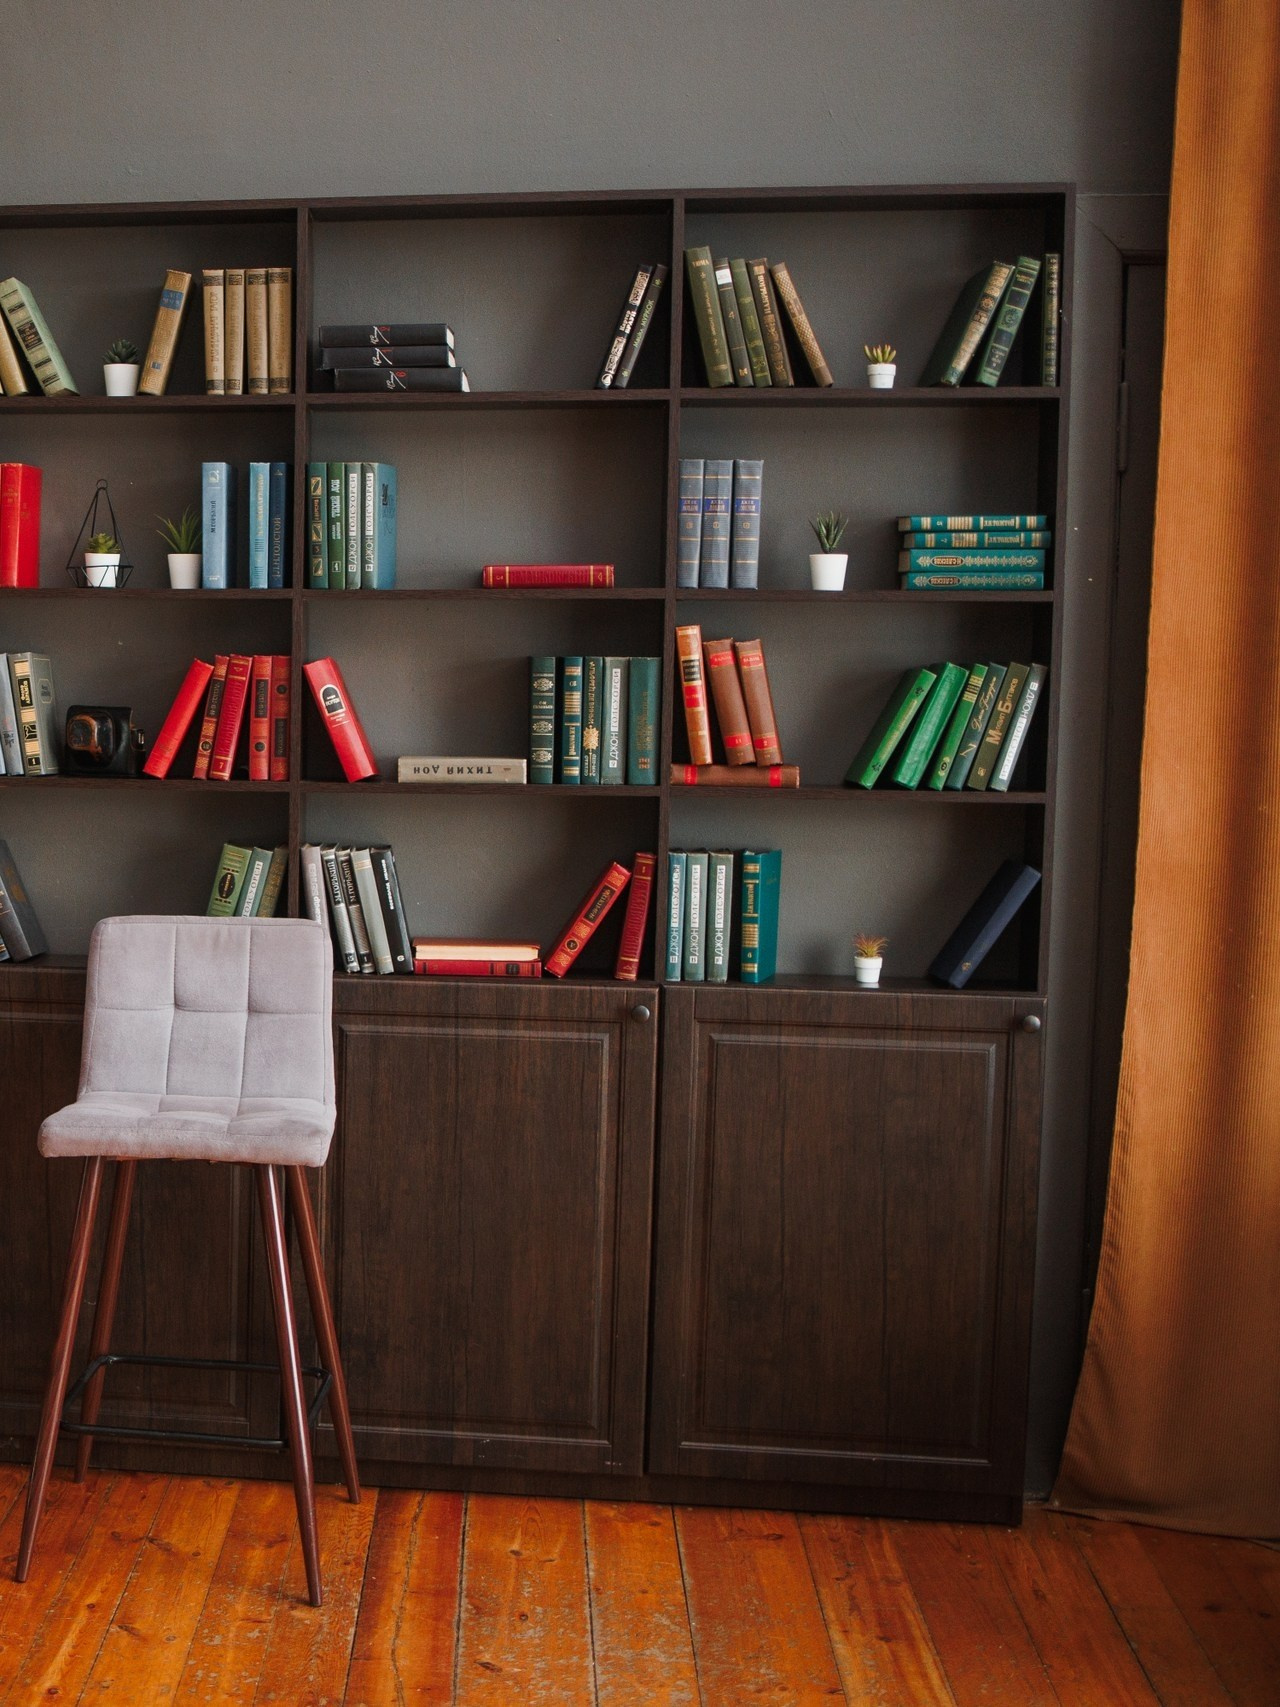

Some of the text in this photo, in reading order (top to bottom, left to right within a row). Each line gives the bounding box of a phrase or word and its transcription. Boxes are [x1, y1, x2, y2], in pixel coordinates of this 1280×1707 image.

[349, 536, 357, 564] ДЖОН
[366, 536, 374, 563] ДЖОН
[1023, 692, 1037, 720] ДЖОН
[609, 732, 618, 760] ДЖОН
[413, 765, 492, 775] ТИХИЙ ДОН
[326, 858, 341, 903] М.ГОРЬКИЙ
[342, 859, 356, 903] М.ГОРЬКИЙ
[714, 867, 725, 956] ДЖОН ГОЛСУОРСИ
[670, 927, 679, 955] ДЖОН
[690, 928, 699, 955] ДЖОН
